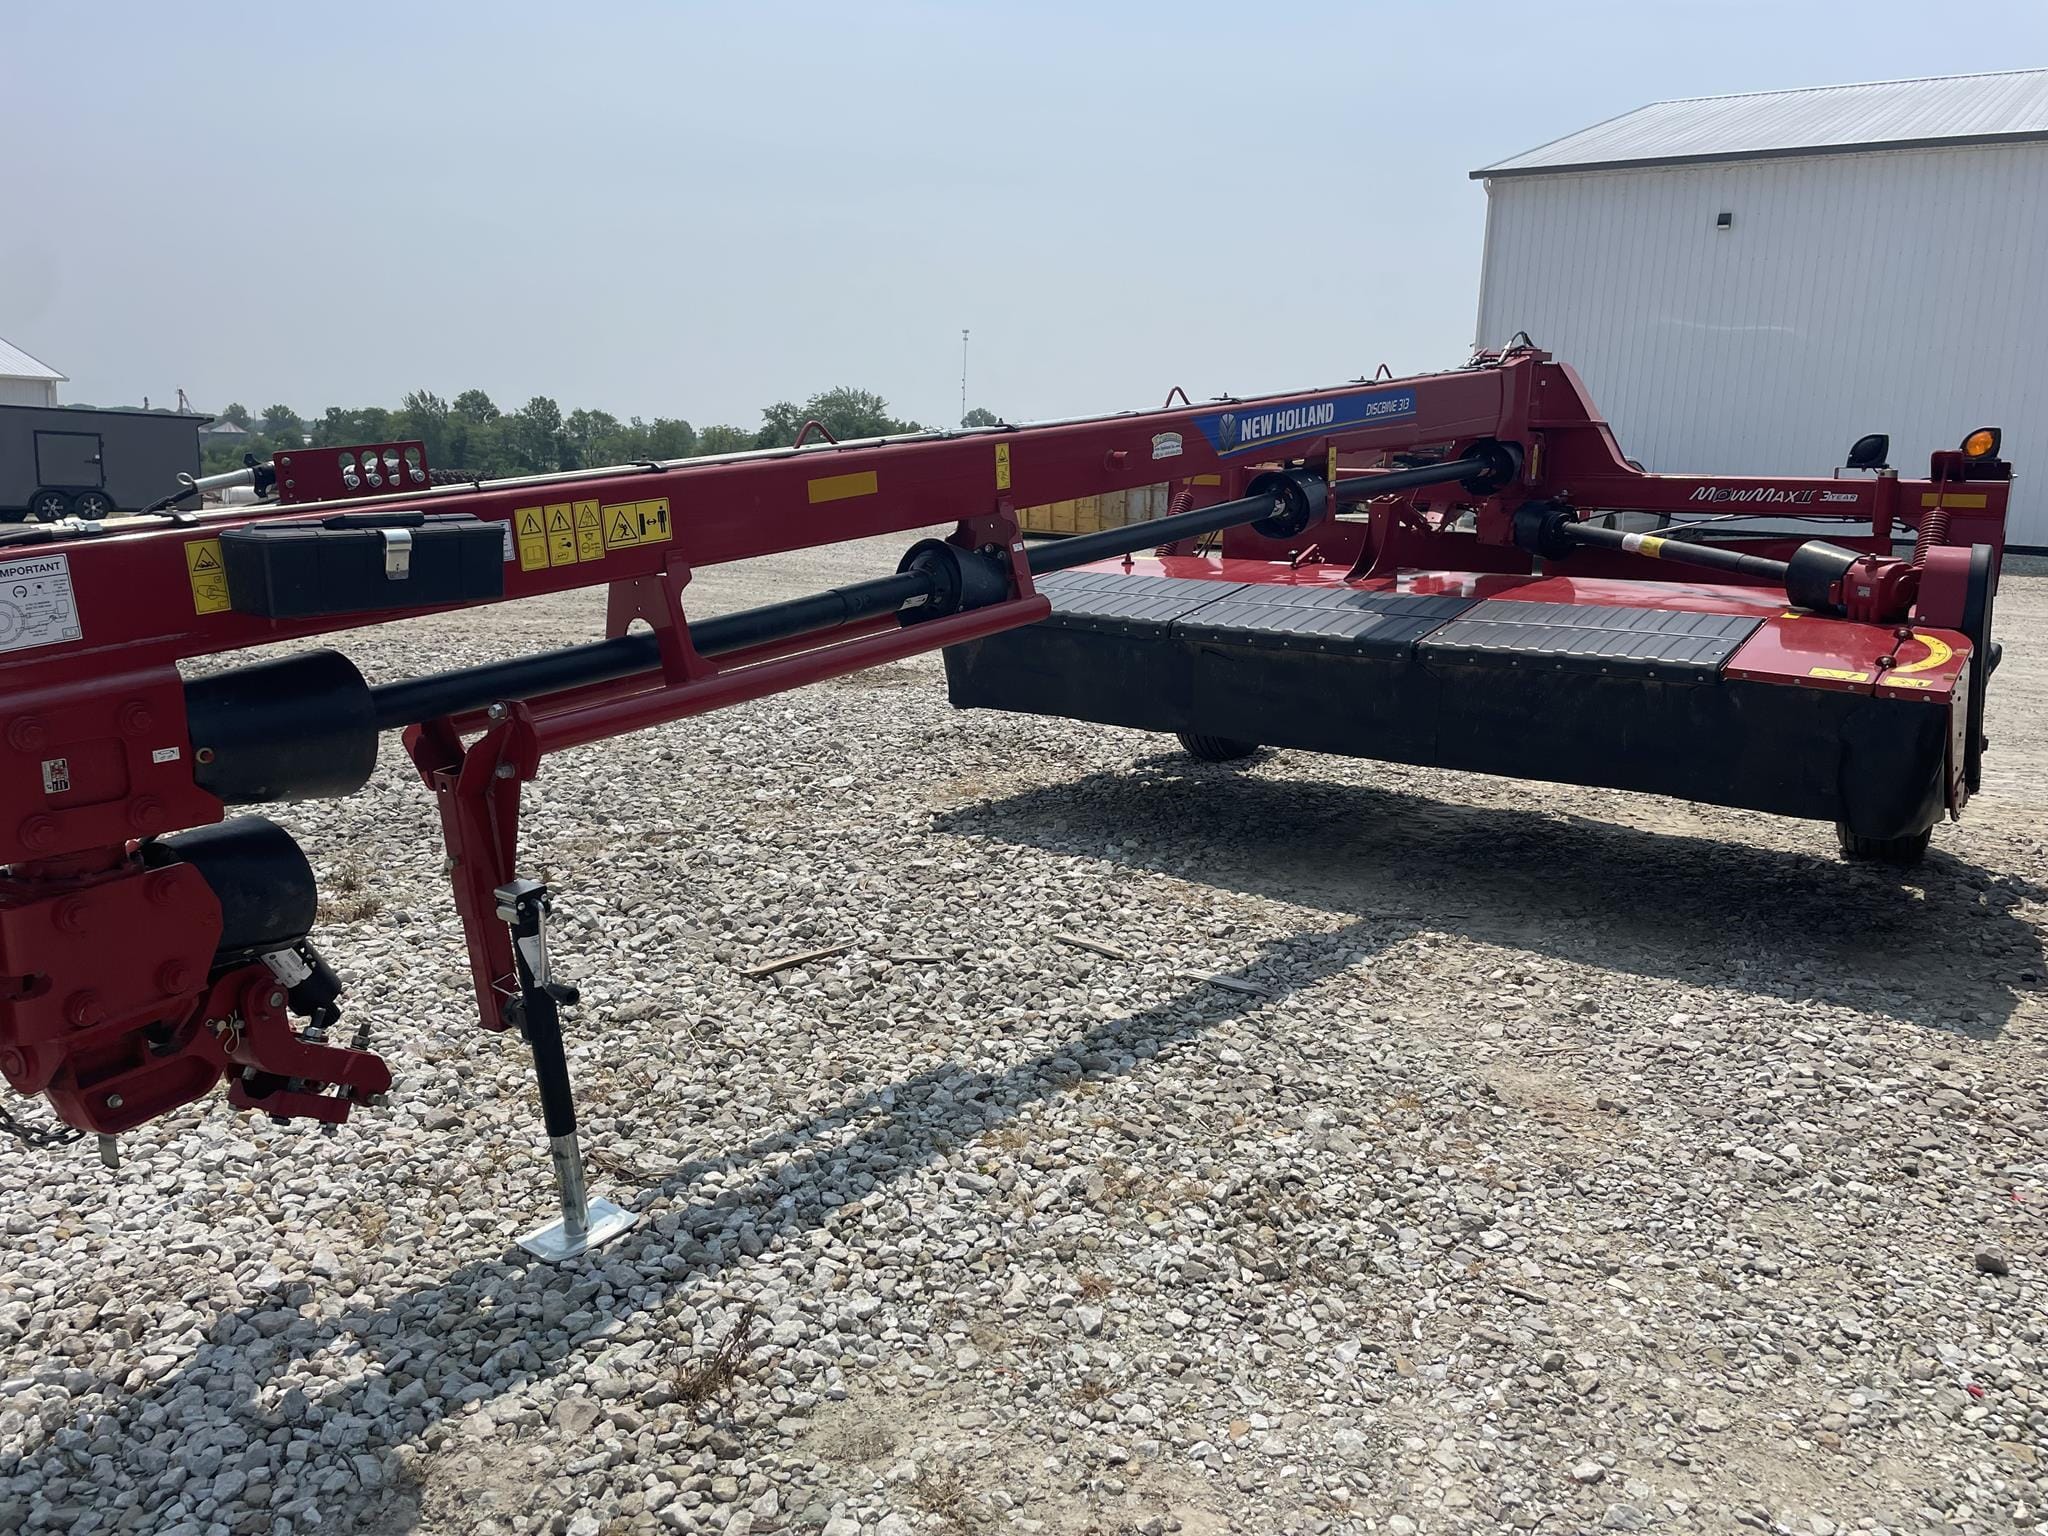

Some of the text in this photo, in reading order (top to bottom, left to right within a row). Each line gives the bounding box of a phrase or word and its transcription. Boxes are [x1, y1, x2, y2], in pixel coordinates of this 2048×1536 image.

[1241, 402, 1334, 441] NEW HOLLAND
[1366, 400, 1397, 416] DISCBINE
